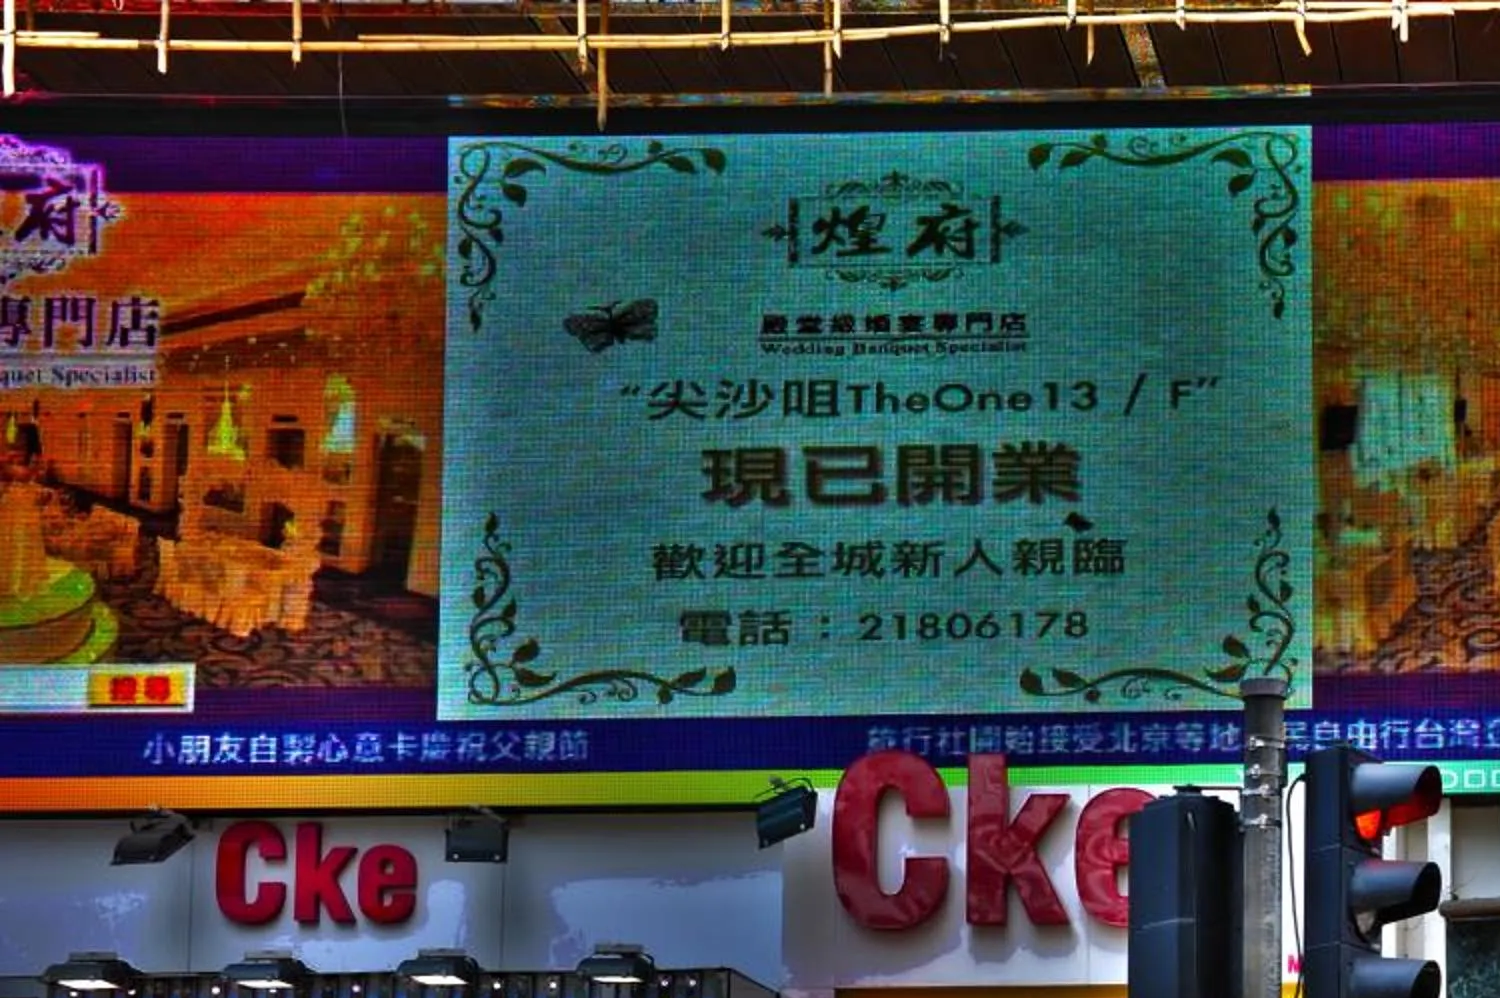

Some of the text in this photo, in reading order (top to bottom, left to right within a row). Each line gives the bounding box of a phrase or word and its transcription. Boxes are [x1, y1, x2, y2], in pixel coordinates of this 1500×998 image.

[811, 204, 979, 258] 煌府
[760, 340, 1027, 356] Wedding Banquet Specialist
[51, 366, 157, 387] Specialist
[700, 440, 1084, 508] 現已開業
[653, 537, 1128, 581] 歡迎全城新人親臨
[857, 612, 1091, 641] 21806178
[215, 821, 418, 926] Cke
